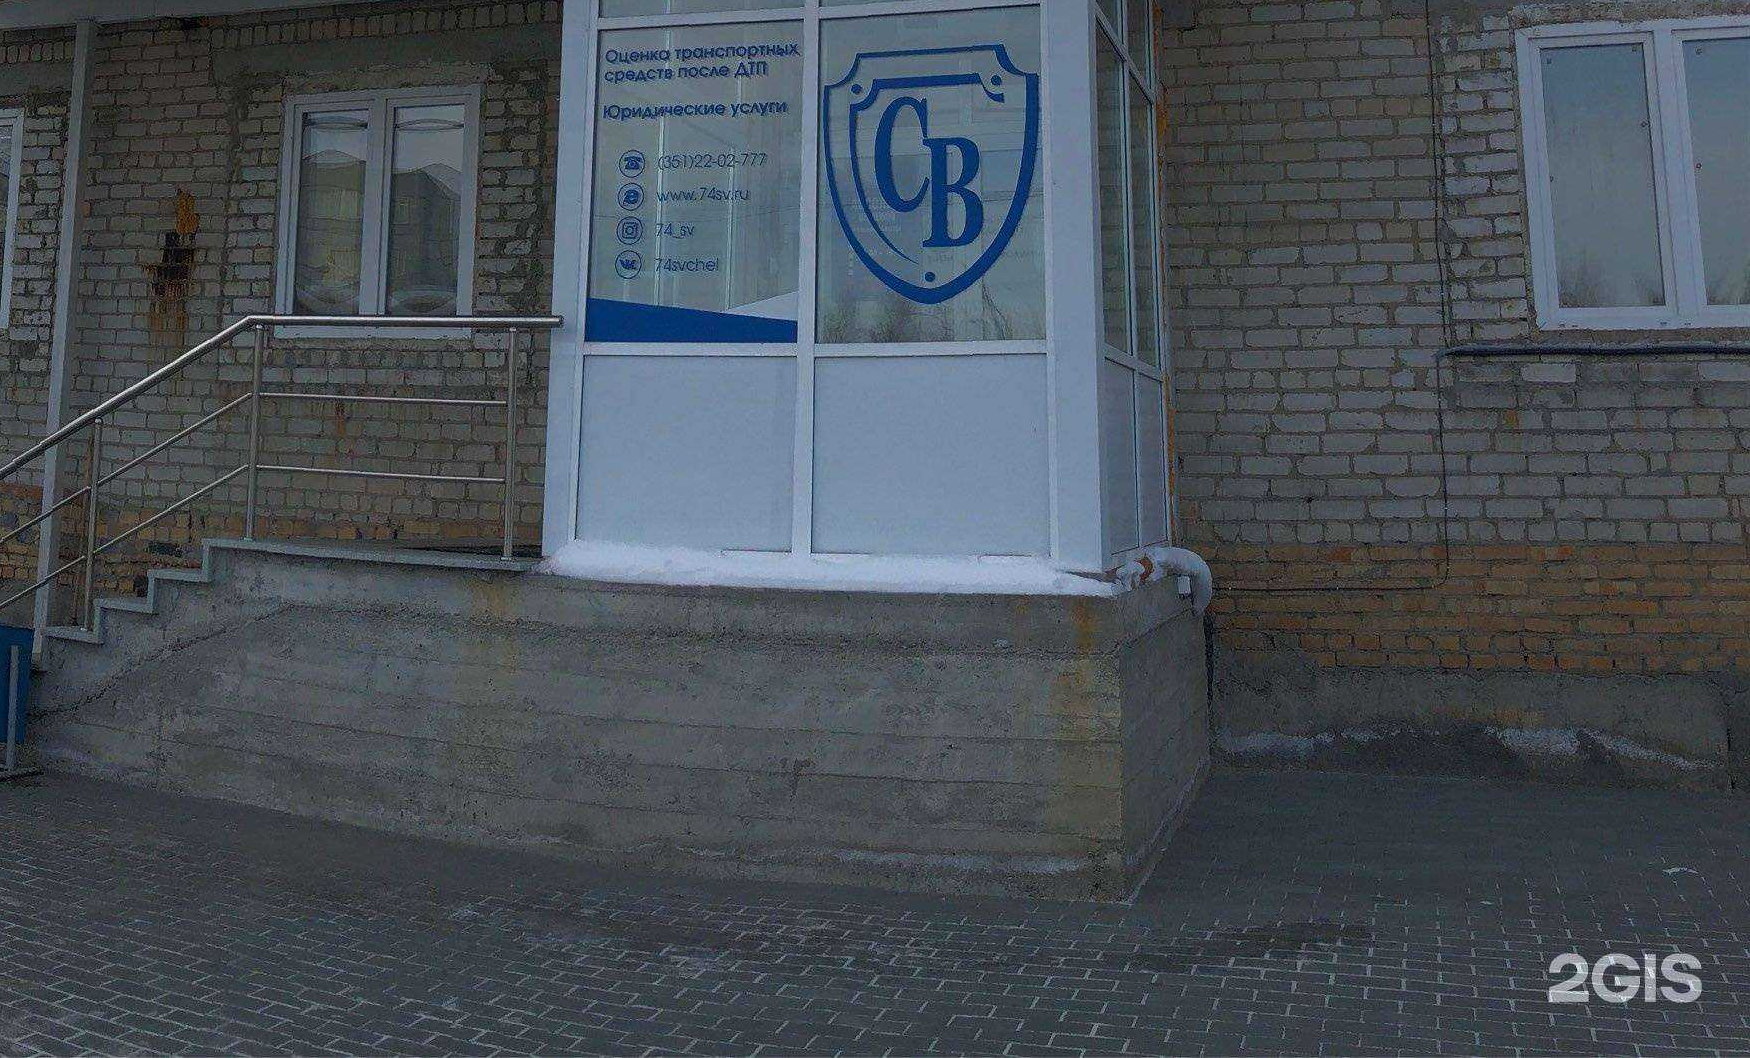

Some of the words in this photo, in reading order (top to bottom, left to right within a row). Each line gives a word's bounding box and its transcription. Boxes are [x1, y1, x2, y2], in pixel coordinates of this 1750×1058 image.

[605, 48, 670, 64] Оценка
[675, 43, 800, 61] транспортных
[604, 67, 673, 83] средств
[677, 66, 730, 78] после
[734, 61, 768, 77] ДТП
[603, 103, 725, 120] Юридические
[729, 102, 788, 117] услуги
[657, 188, 749, 202] www.74sv.ru
[656, 223, 694, 239] 74_sv
[655, 258, 719, 272] 74svchel
